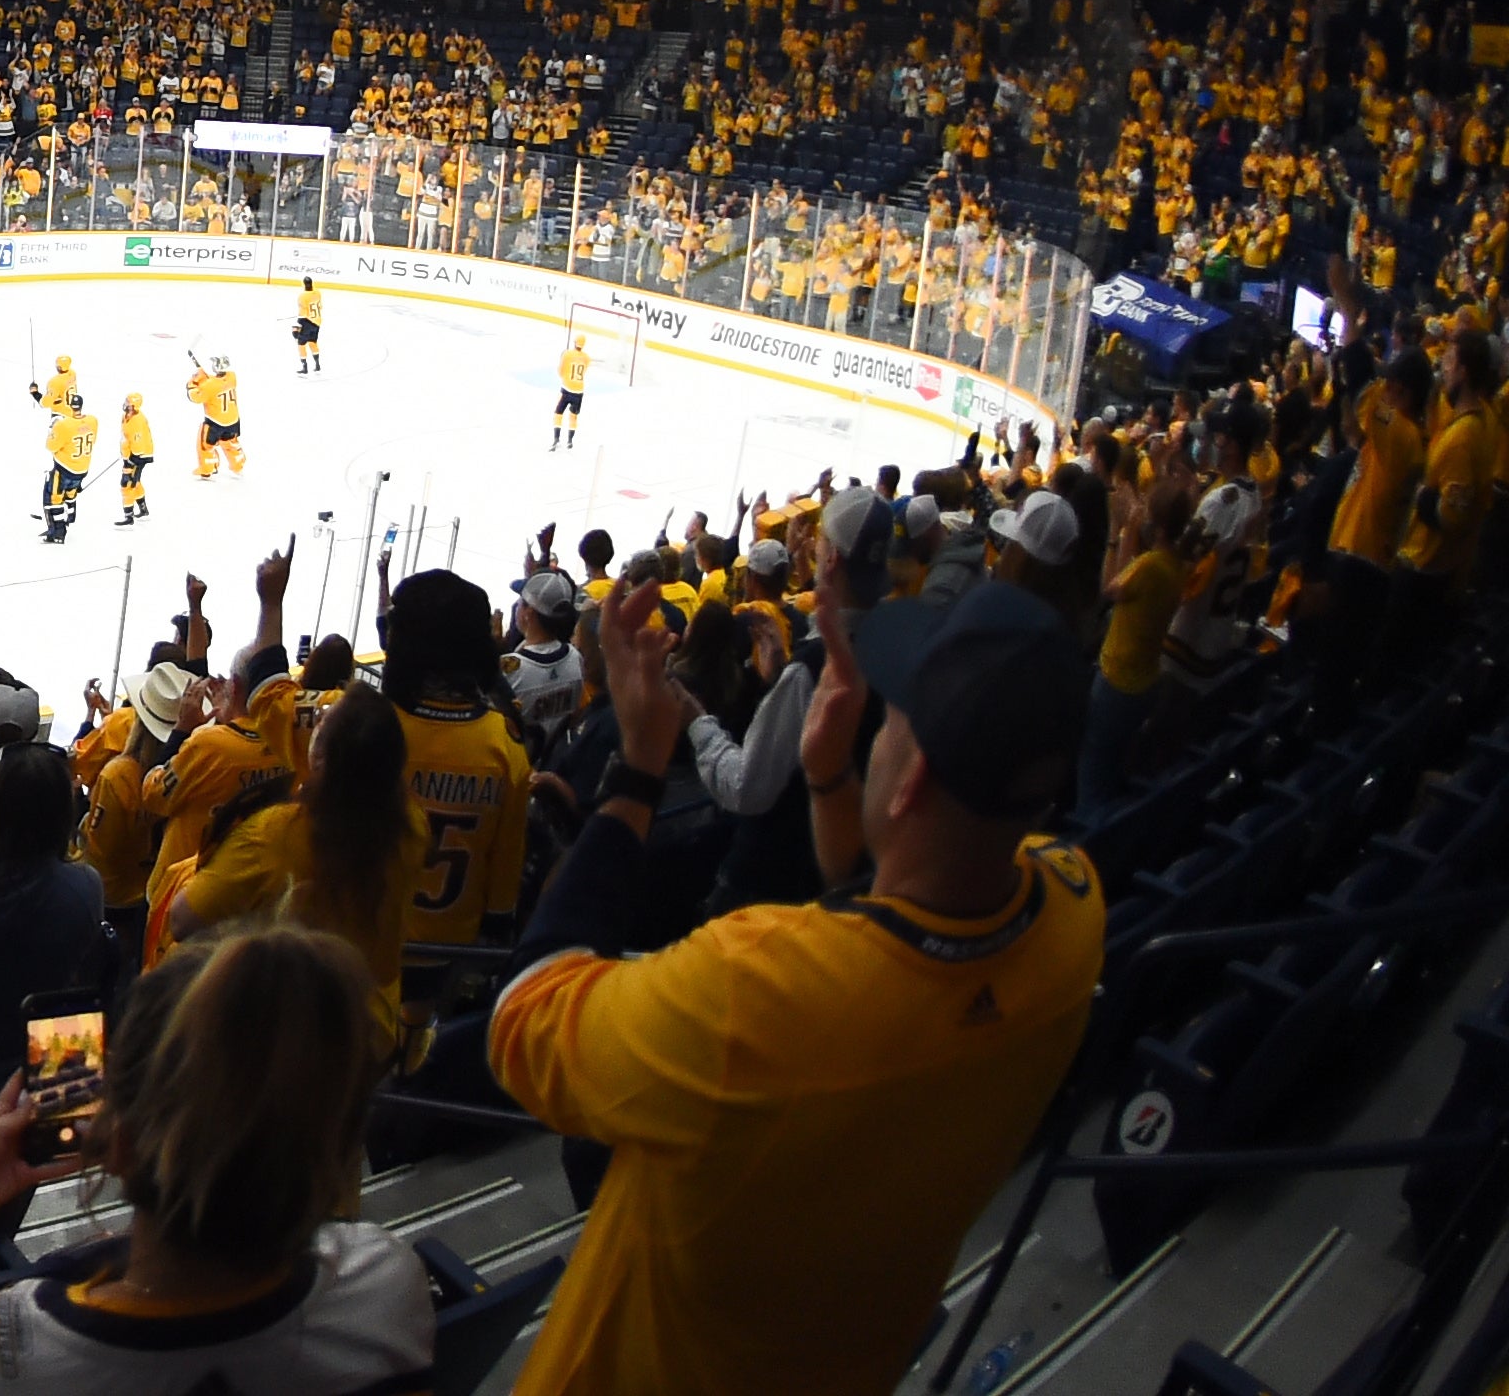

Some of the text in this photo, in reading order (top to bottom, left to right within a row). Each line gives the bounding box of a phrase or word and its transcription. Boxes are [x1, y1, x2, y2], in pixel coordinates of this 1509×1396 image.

[133, 241, 252, 263] enterprise
[357, 256, 473, 287] NISSAN
[709, 321, 821, 366] BRIDGESTONE
[833, 348, 913, 390] guaranteed
[71, 432, 94, 459] 35
[412, 808, 482, 913] 5
